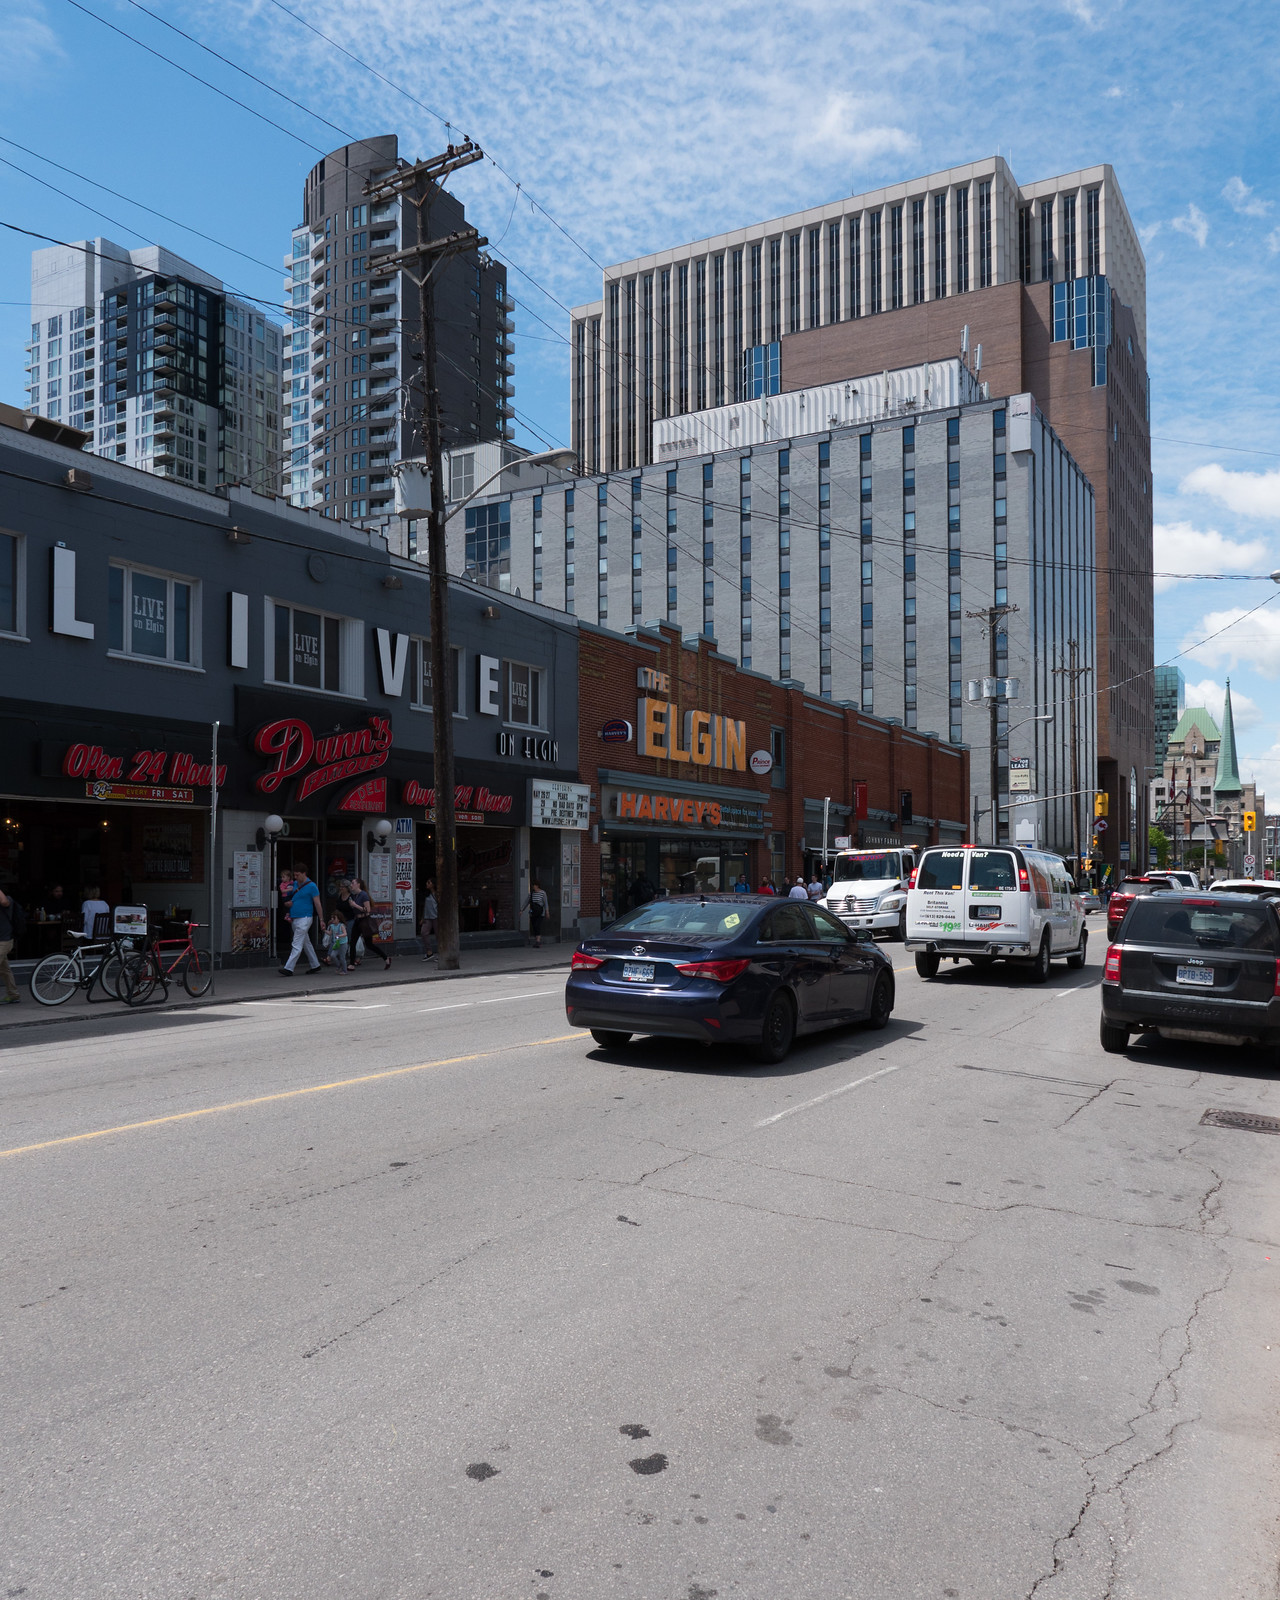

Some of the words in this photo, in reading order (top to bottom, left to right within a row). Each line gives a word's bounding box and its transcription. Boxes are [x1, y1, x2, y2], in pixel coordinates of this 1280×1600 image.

[134, 595, 165, 620] LIVE
[134, 619, 143, 629] on
[145, 618, 165, 634] Elgin
[294, 633, 318, 655] LIVE
[294, 654, 302, 663] on
[303, 653, 319, 666] Elgin
[512, 681, 528, 698] LIVE
[637, 666, 670, 693] THE
[517, 697, 528, 707] Elgin
[637, 697, 747, 772] ELGIN
[254, 716, 393, 794] Dunn's
[497, 732, 515, 757] ON
[522, 736, 560, 762] ELGIN
[127, 750, 168, 783] 24
[308, 753, 383, 792] FAMOUS
[126, 788, 147, 796] EVERY
[151, 789, 165, 798] FRI
[172, 790, 188, 799] SAT
[357, 777, 385, 800] DELI
[402, 780, 436, 807] Ouve
[474, 786, 513, 813] Heures
[1015, 794, 1036, 803] 200
[616, 792, 722, 826] HARVEY'S
[396, 819, 412, 833] ATM
[235, 910, 250, 919] DINNER
[250, 909, 266, 918] SPECIAL
[1187, 957, 1204, 966] Jeep
